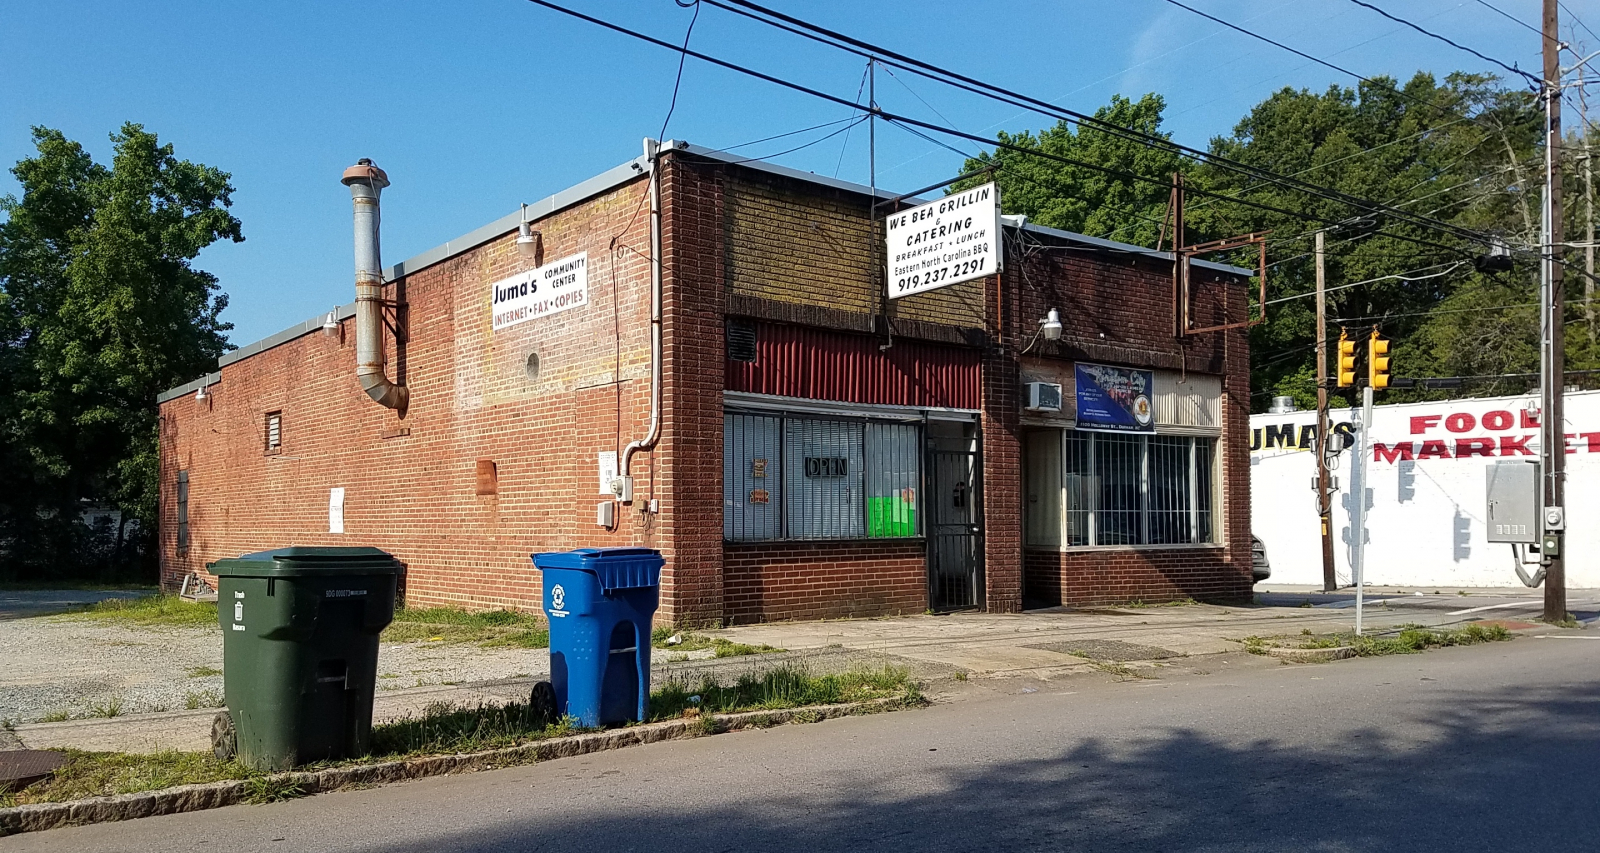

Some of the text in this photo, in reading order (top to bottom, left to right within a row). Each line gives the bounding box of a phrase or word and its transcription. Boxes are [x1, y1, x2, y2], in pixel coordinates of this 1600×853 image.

[890, 187, 990, 230] WE BEA GRILLIN
[935, 217, 941, 226] &
[895, 229, 986, 262] BREAKFAST LUNCH
[906, 217, 973, 246] CATERING
[544, 257, 585, 280] COMMUNITY
[895, 242, 989, 276] Eastern North Carolina BBQ
[898, 257, 985, 292] 919.237.2291
[494, 273, 576, 304] Juma's CENTER
[494, 289, 584, 327] INTERNET FAX COPIES
[809, 459, 847, 476] OPEN
